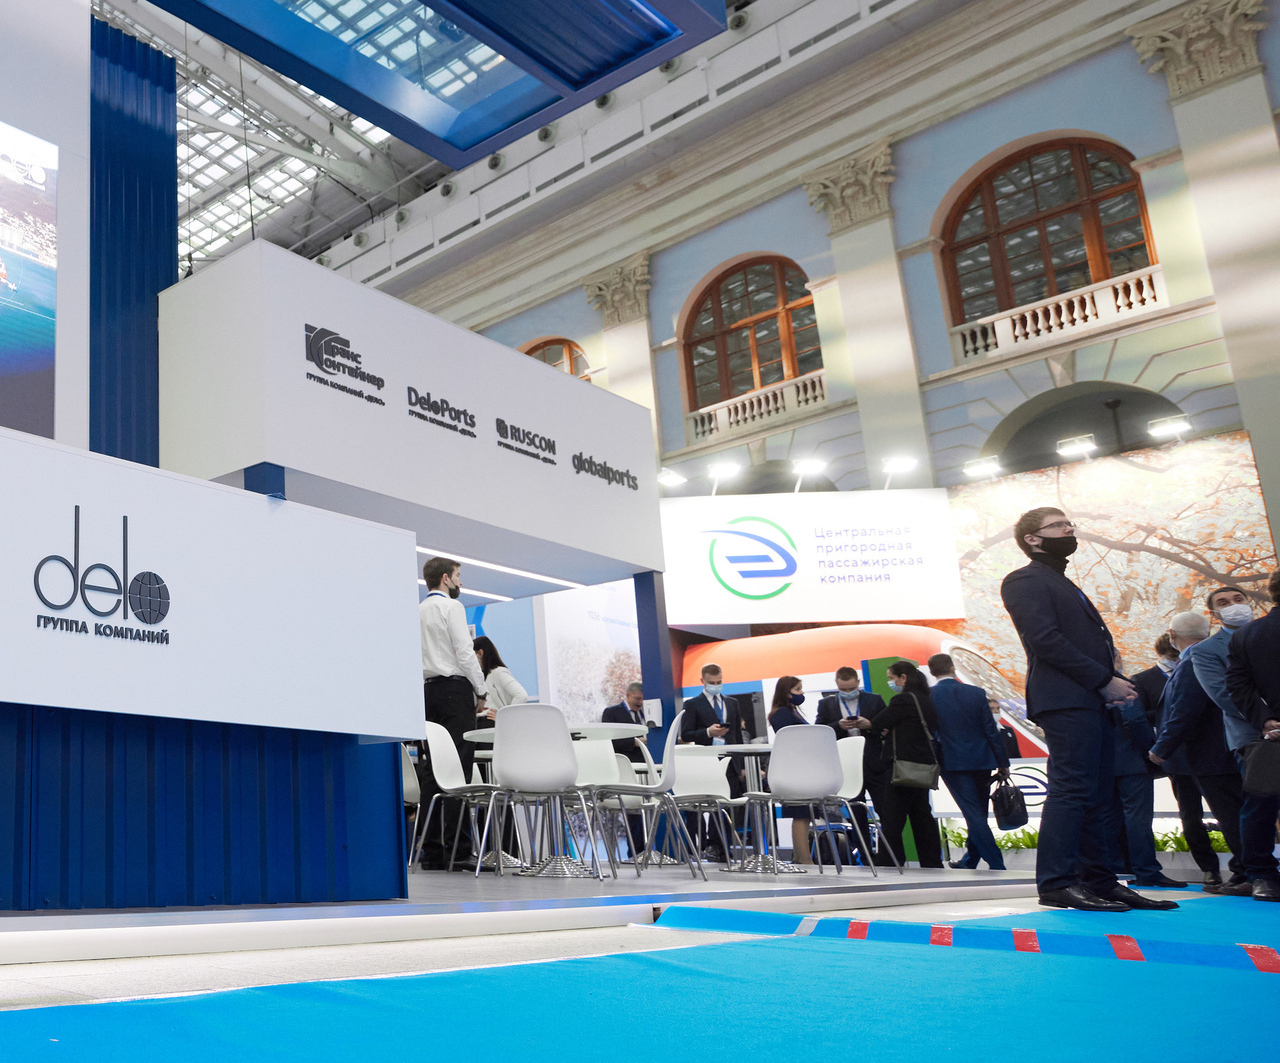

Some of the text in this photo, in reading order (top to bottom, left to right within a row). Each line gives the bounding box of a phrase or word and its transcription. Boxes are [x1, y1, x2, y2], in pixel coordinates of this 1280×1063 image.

[407, 386, 476, 429] DeloPorts
[510, 424, 556, 455] RUSCON
[572, 451, 638, 491] globalports
[814, 526, 911, 540] Центральная
[816, 542, 912, 556] пригородная
[818, 557, 923, 569] пассажирская
[820, 573, 891, 584] компания
[36, 614, 170, 645] ГРУППА КОМПАНИЙ
